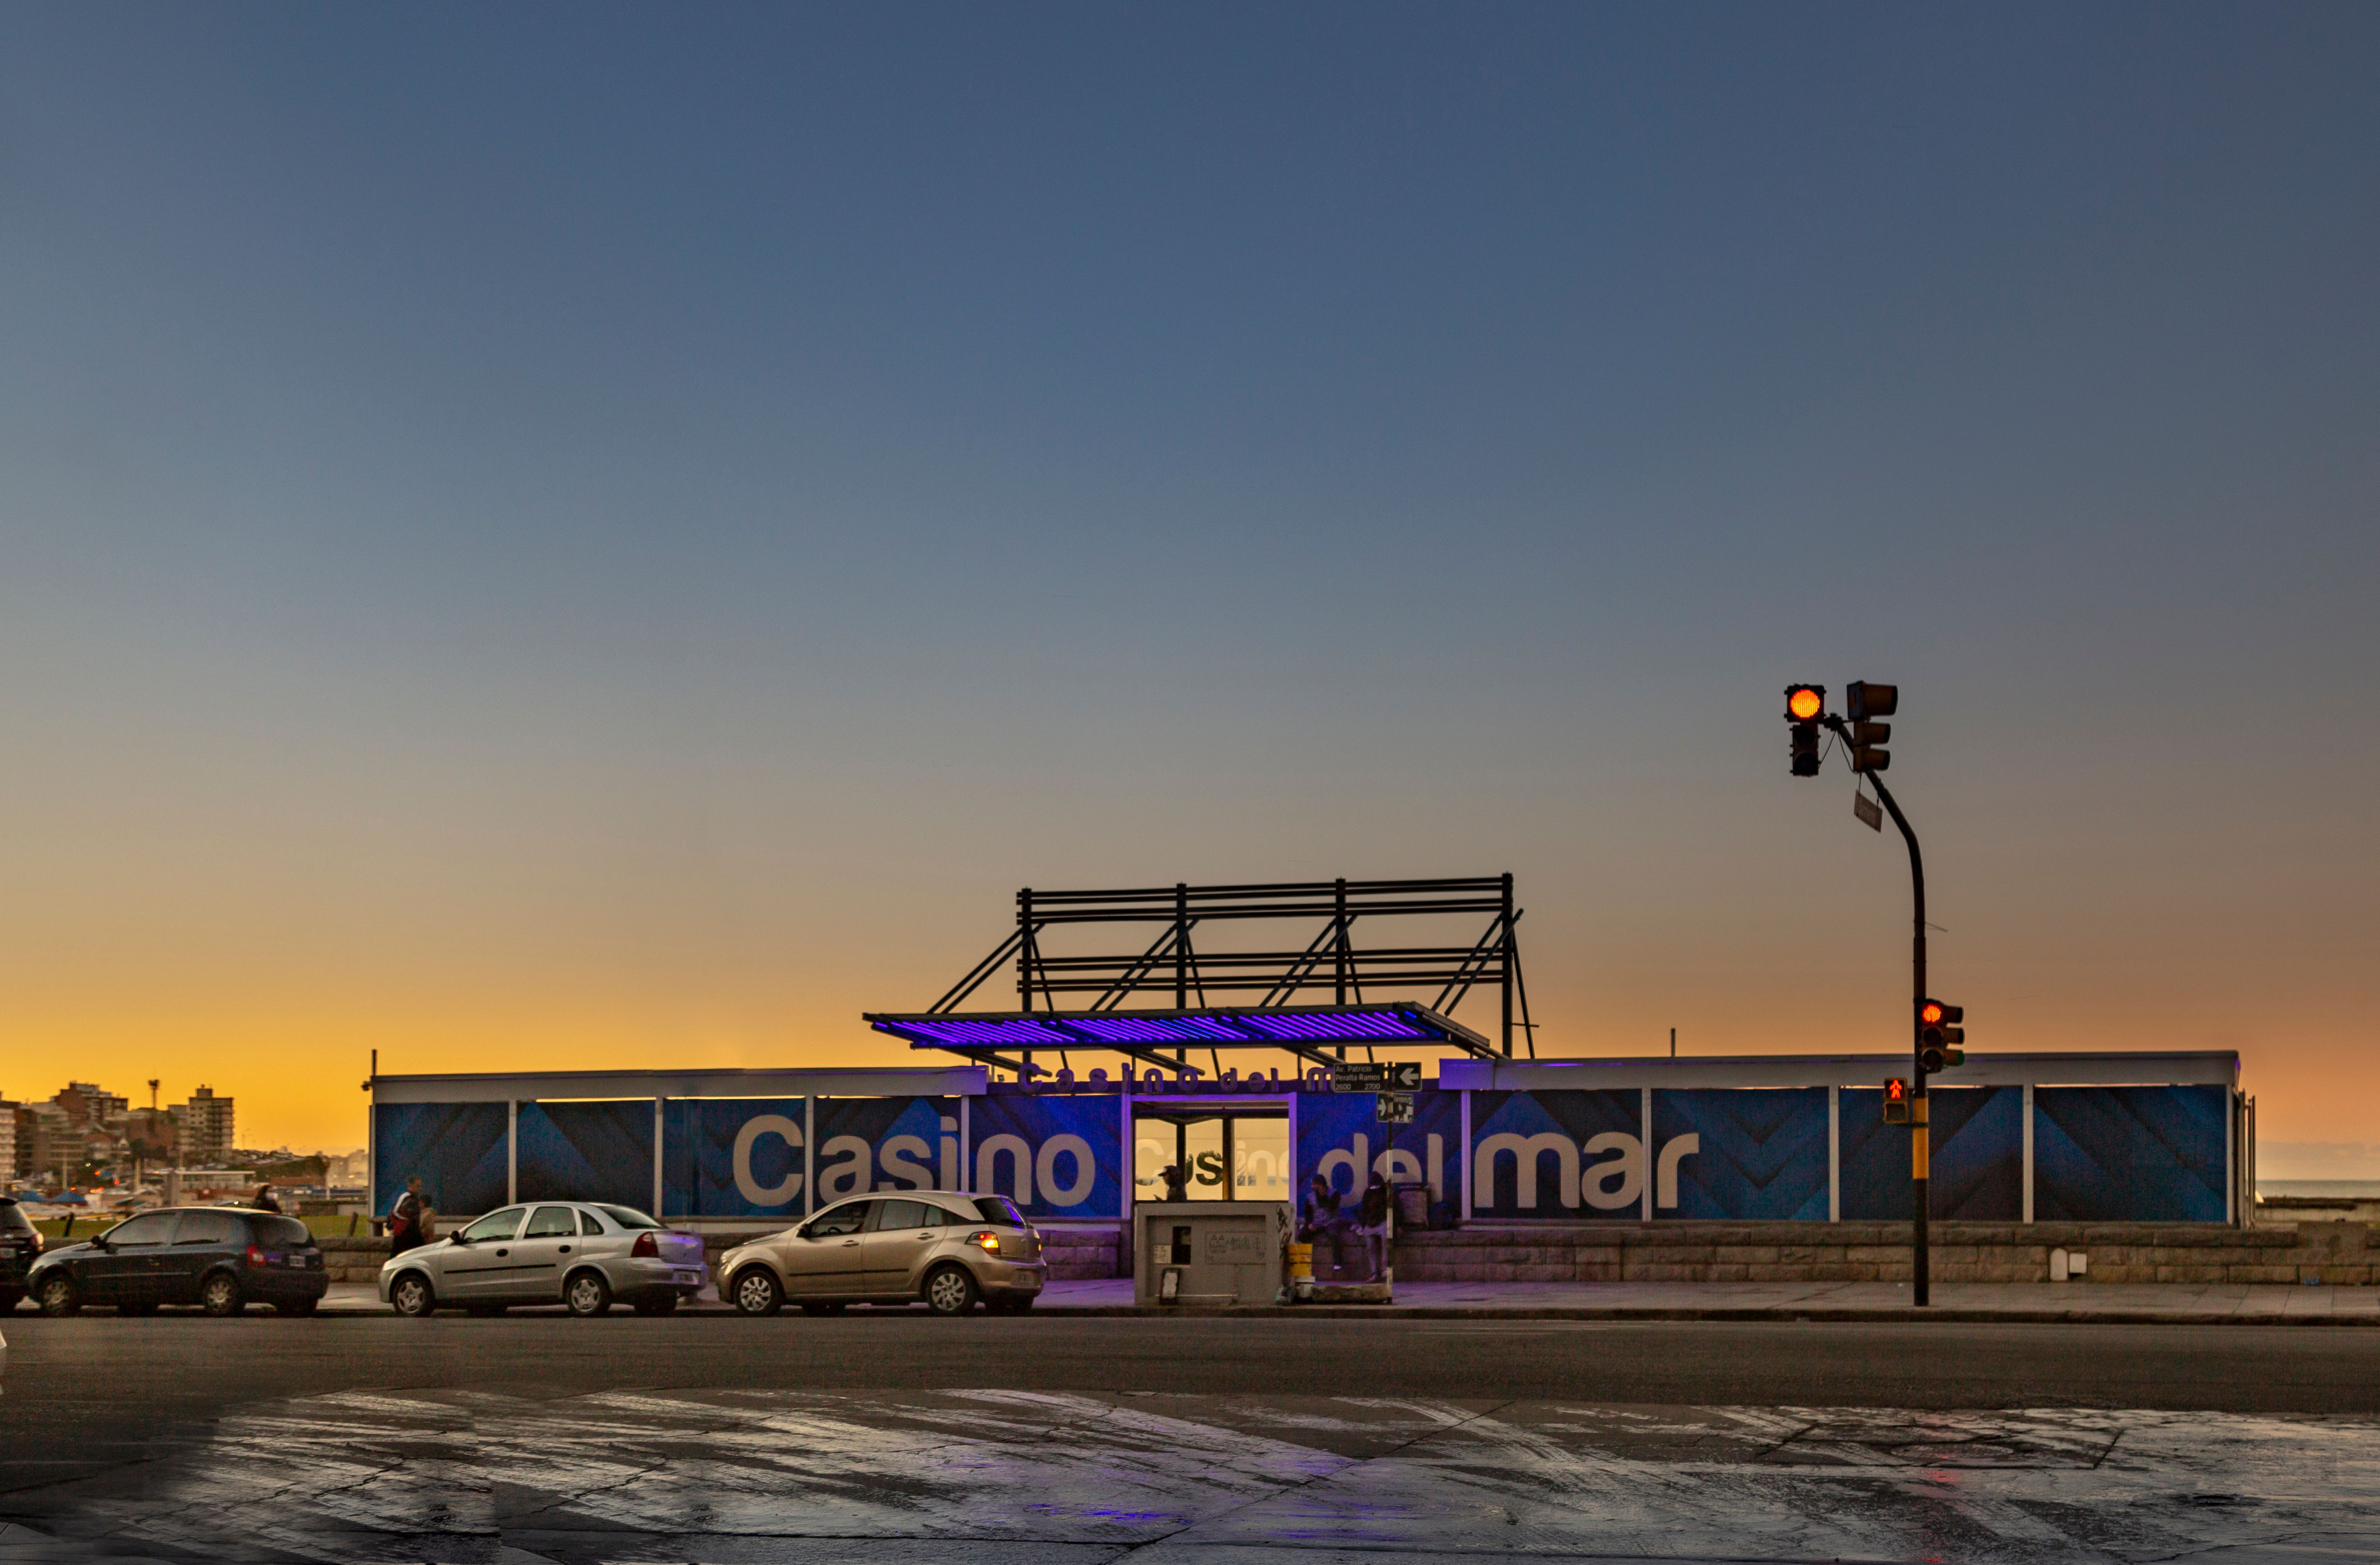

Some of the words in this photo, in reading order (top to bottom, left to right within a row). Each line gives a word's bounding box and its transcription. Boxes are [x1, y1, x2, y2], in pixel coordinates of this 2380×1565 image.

[1017, 1062, 1198, 1093] Casino
[1220, 1067, 1279, 1092] del
[732, 1114, 1096, 1208] Casino
[1474, 1131, 1700, 1209] mar
